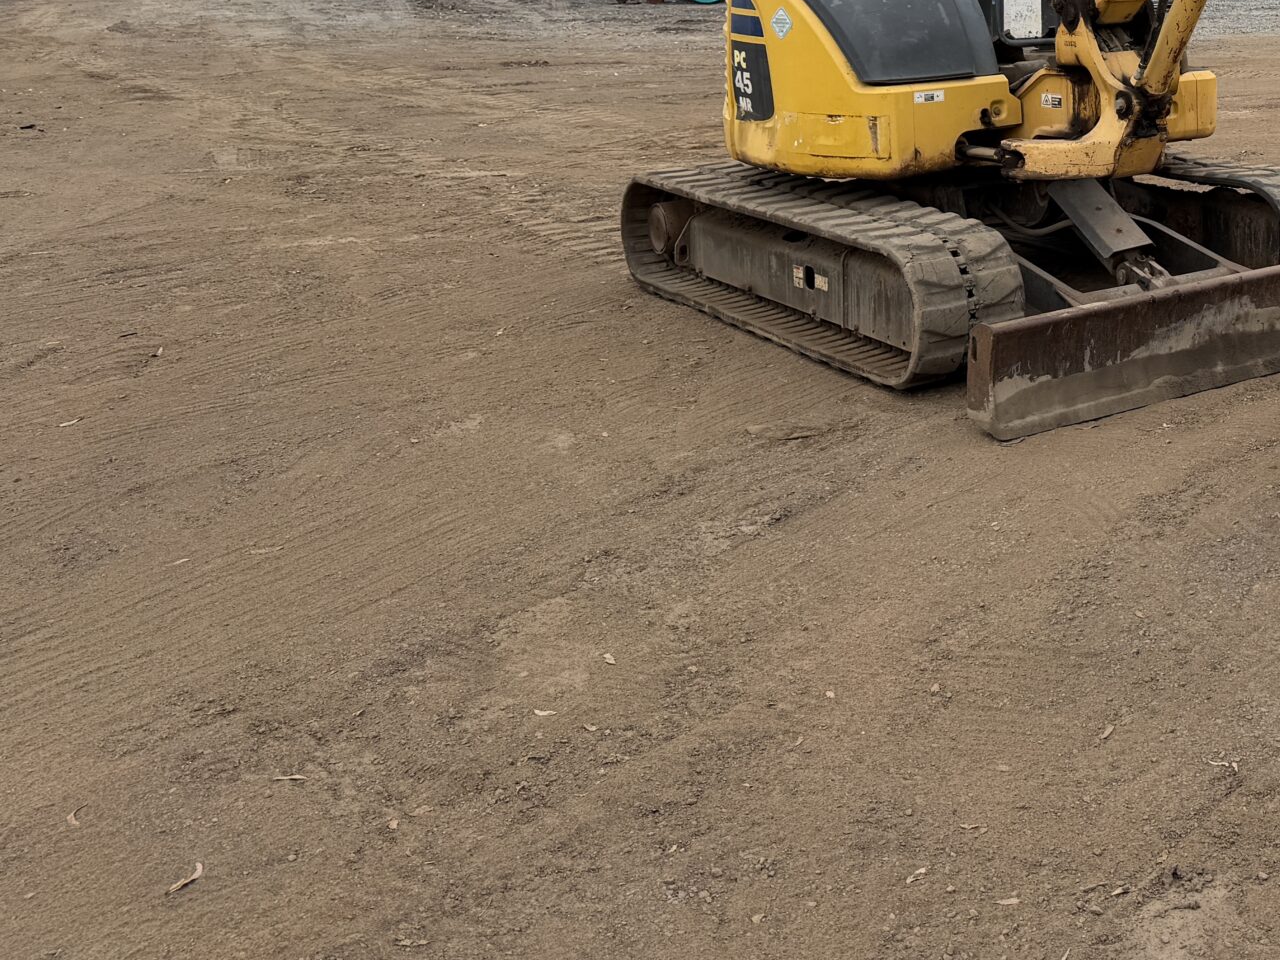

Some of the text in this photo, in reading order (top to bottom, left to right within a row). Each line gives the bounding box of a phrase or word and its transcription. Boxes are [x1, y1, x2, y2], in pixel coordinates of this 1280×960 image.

[733, 49, 747, 69] PC
[735, 70, 753, 95] 45
[738, 96, 753, 112] MR
